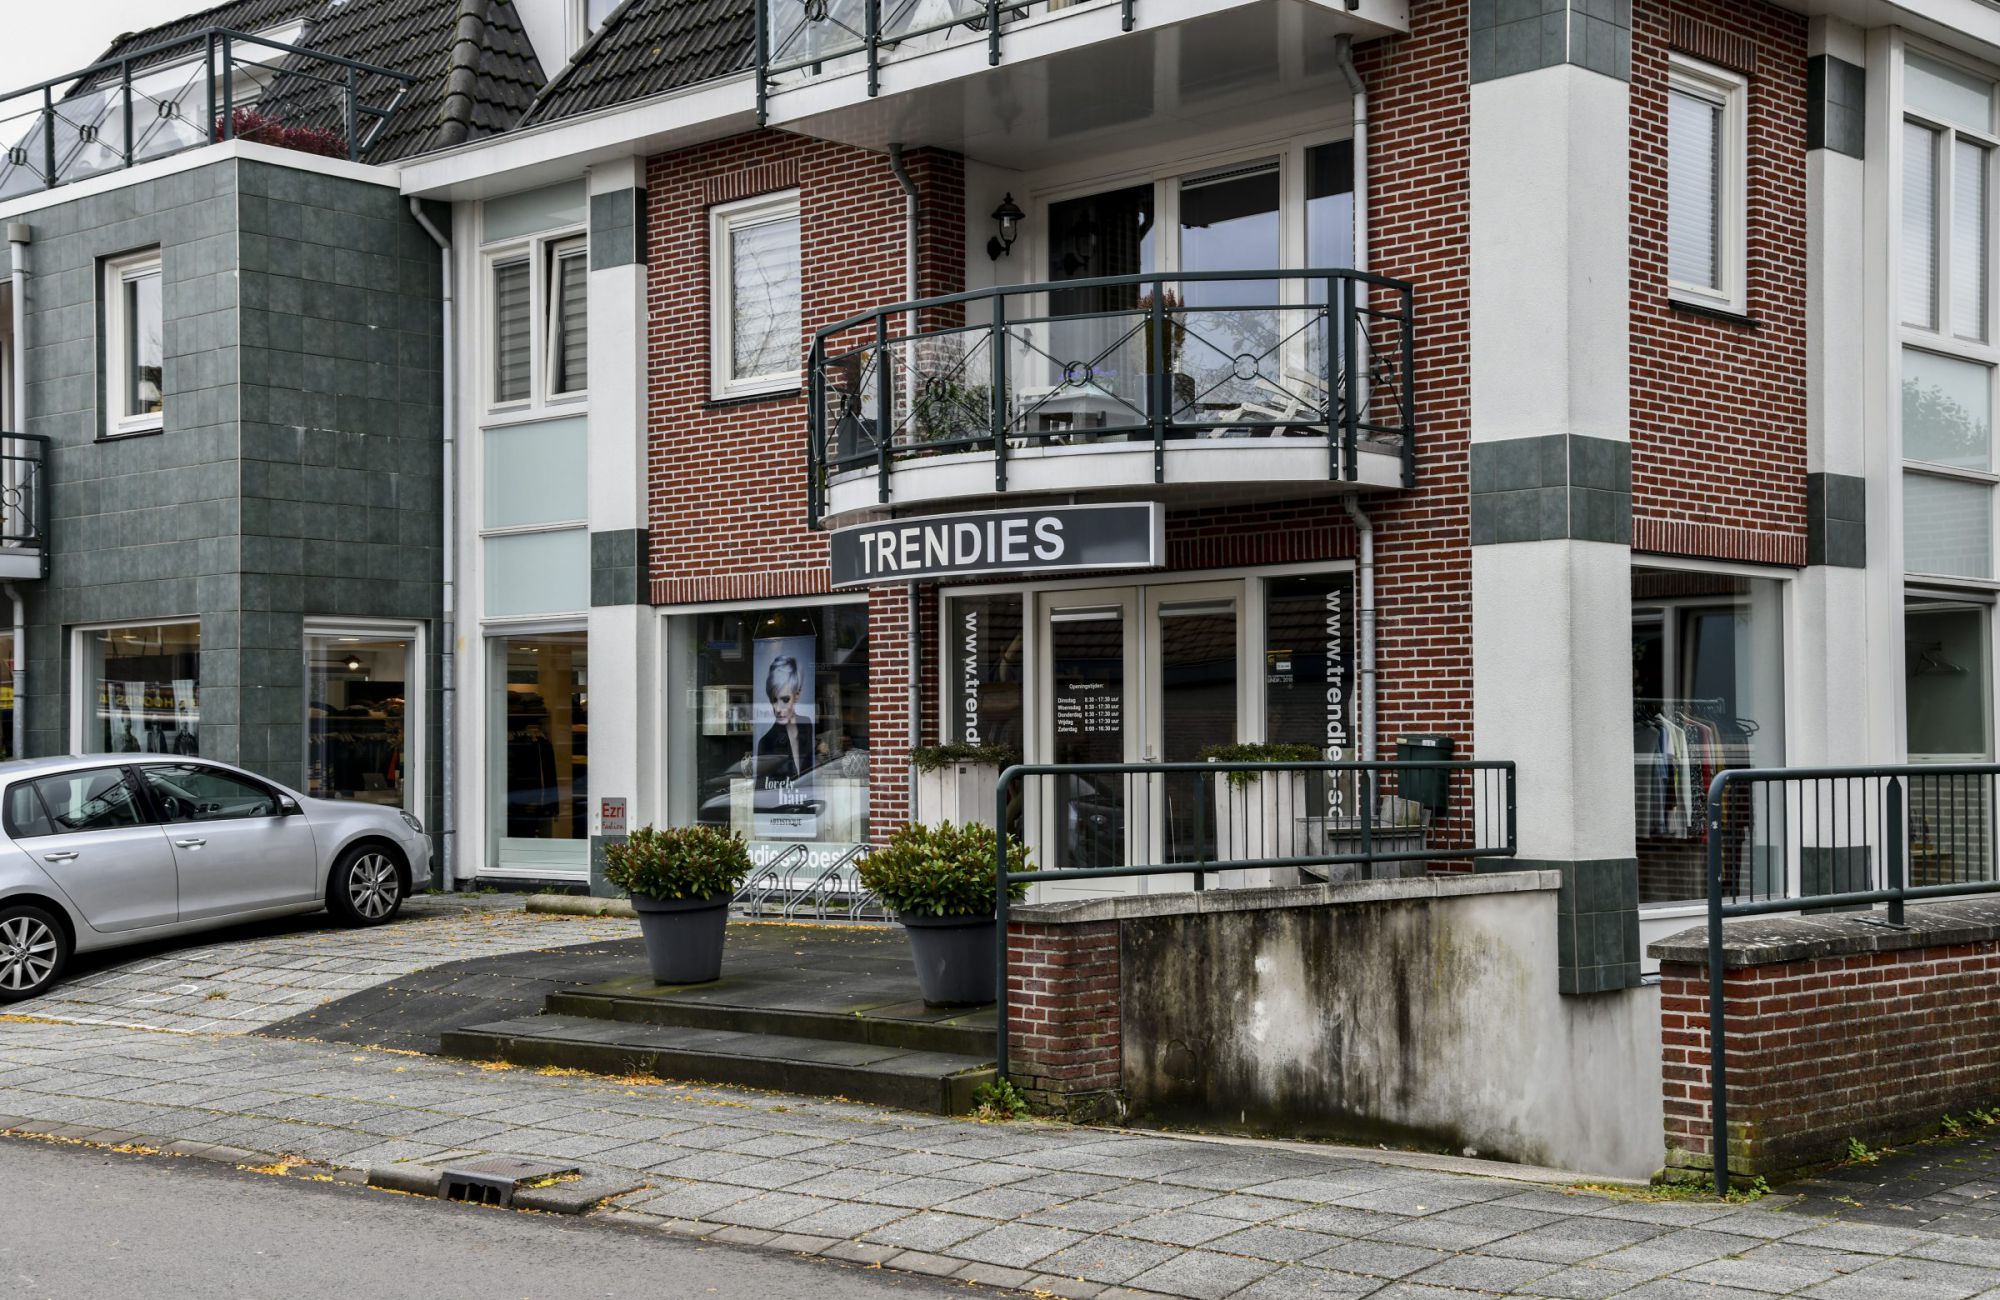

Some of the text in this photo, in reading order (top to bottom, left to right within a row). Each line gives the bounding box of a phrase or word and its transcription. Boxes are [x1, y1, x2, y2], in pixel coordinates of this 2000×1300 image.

[859, 516, 1065, 575] TRENDIES
[965, 611, 981, 748] www.trend
[764, 776, 795, 790] lovely
[778, 787, 807, 805] hair
[602, 802, 625, 818] Ezri
